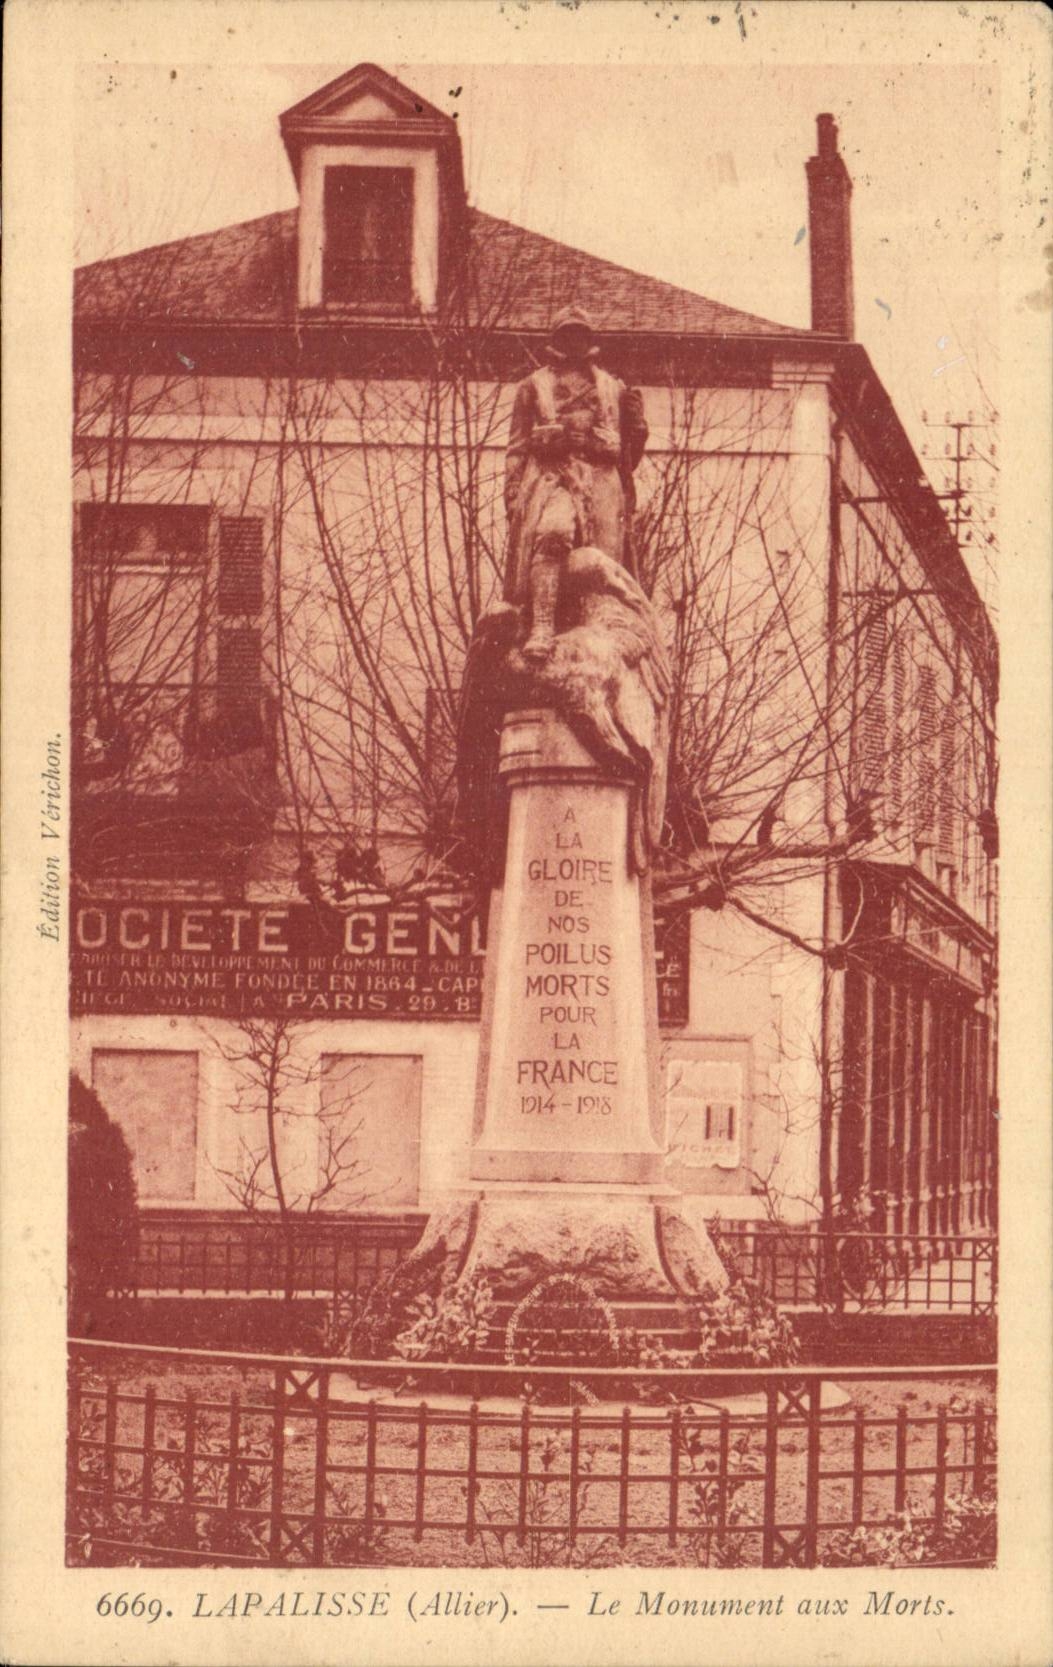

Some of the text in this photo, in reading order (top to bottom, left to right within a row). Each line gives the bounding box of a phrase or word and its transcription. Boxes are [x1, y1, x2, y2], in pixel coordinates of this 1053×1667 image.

[563, 807, 577, 824] A
[555, 832, 584, 849] LA
[527, 858, 614, 886] GLOIRE
[554, 889, 584, 908] DE
[547, 915, 591, 934] NOS
[308, 956, 326, 971] DU
[332, 954, 422, 973] COMMERCE
[525, 943, 613, 966] POILUS
[118, 969, 226, 990] ANONYME
[329, 974, 357, 992] EN
[367, 974, 417, 992] 1864
[525, 974, 610, 1000] MORTS
[539, 1005, 598, 1027] POUR
[553, 1031, 581, 1050] LA
[516, 1059, 618, 1090] FRANCE
[520, 1093, 556, 1115] 1914
[577, 1095, 613, 1116] 1918
